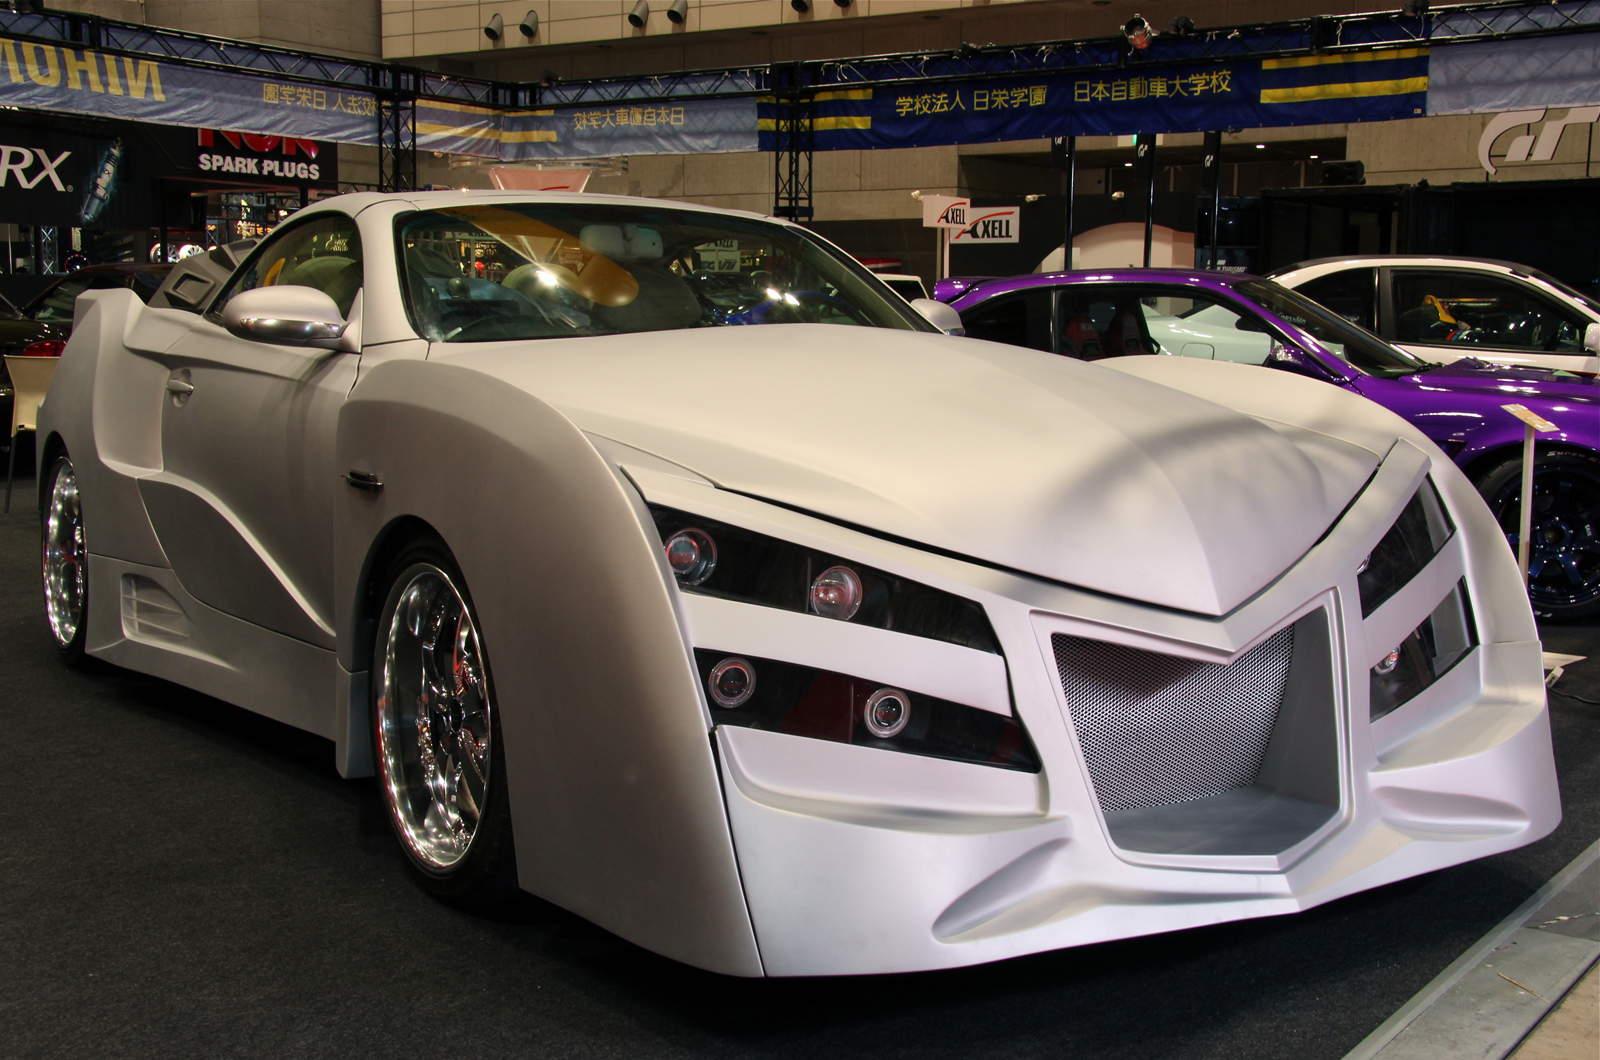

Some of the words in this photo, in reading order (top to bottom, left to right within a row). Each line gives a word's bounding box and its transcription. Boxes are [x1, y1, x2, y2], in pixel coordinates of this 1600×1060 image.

[896, 90, 966, 117] 学校法人
[974, 85, 1048, 111] 日栄学園
[1074, 69, 1232, 102] 日本自動車大学校
[198, 153, 260, 175] SPARK
[262, 159, 320, 180] PLUGS
[937, 202, 968, 225] AXELL
[955, 212, 1014, 239] AXELL
